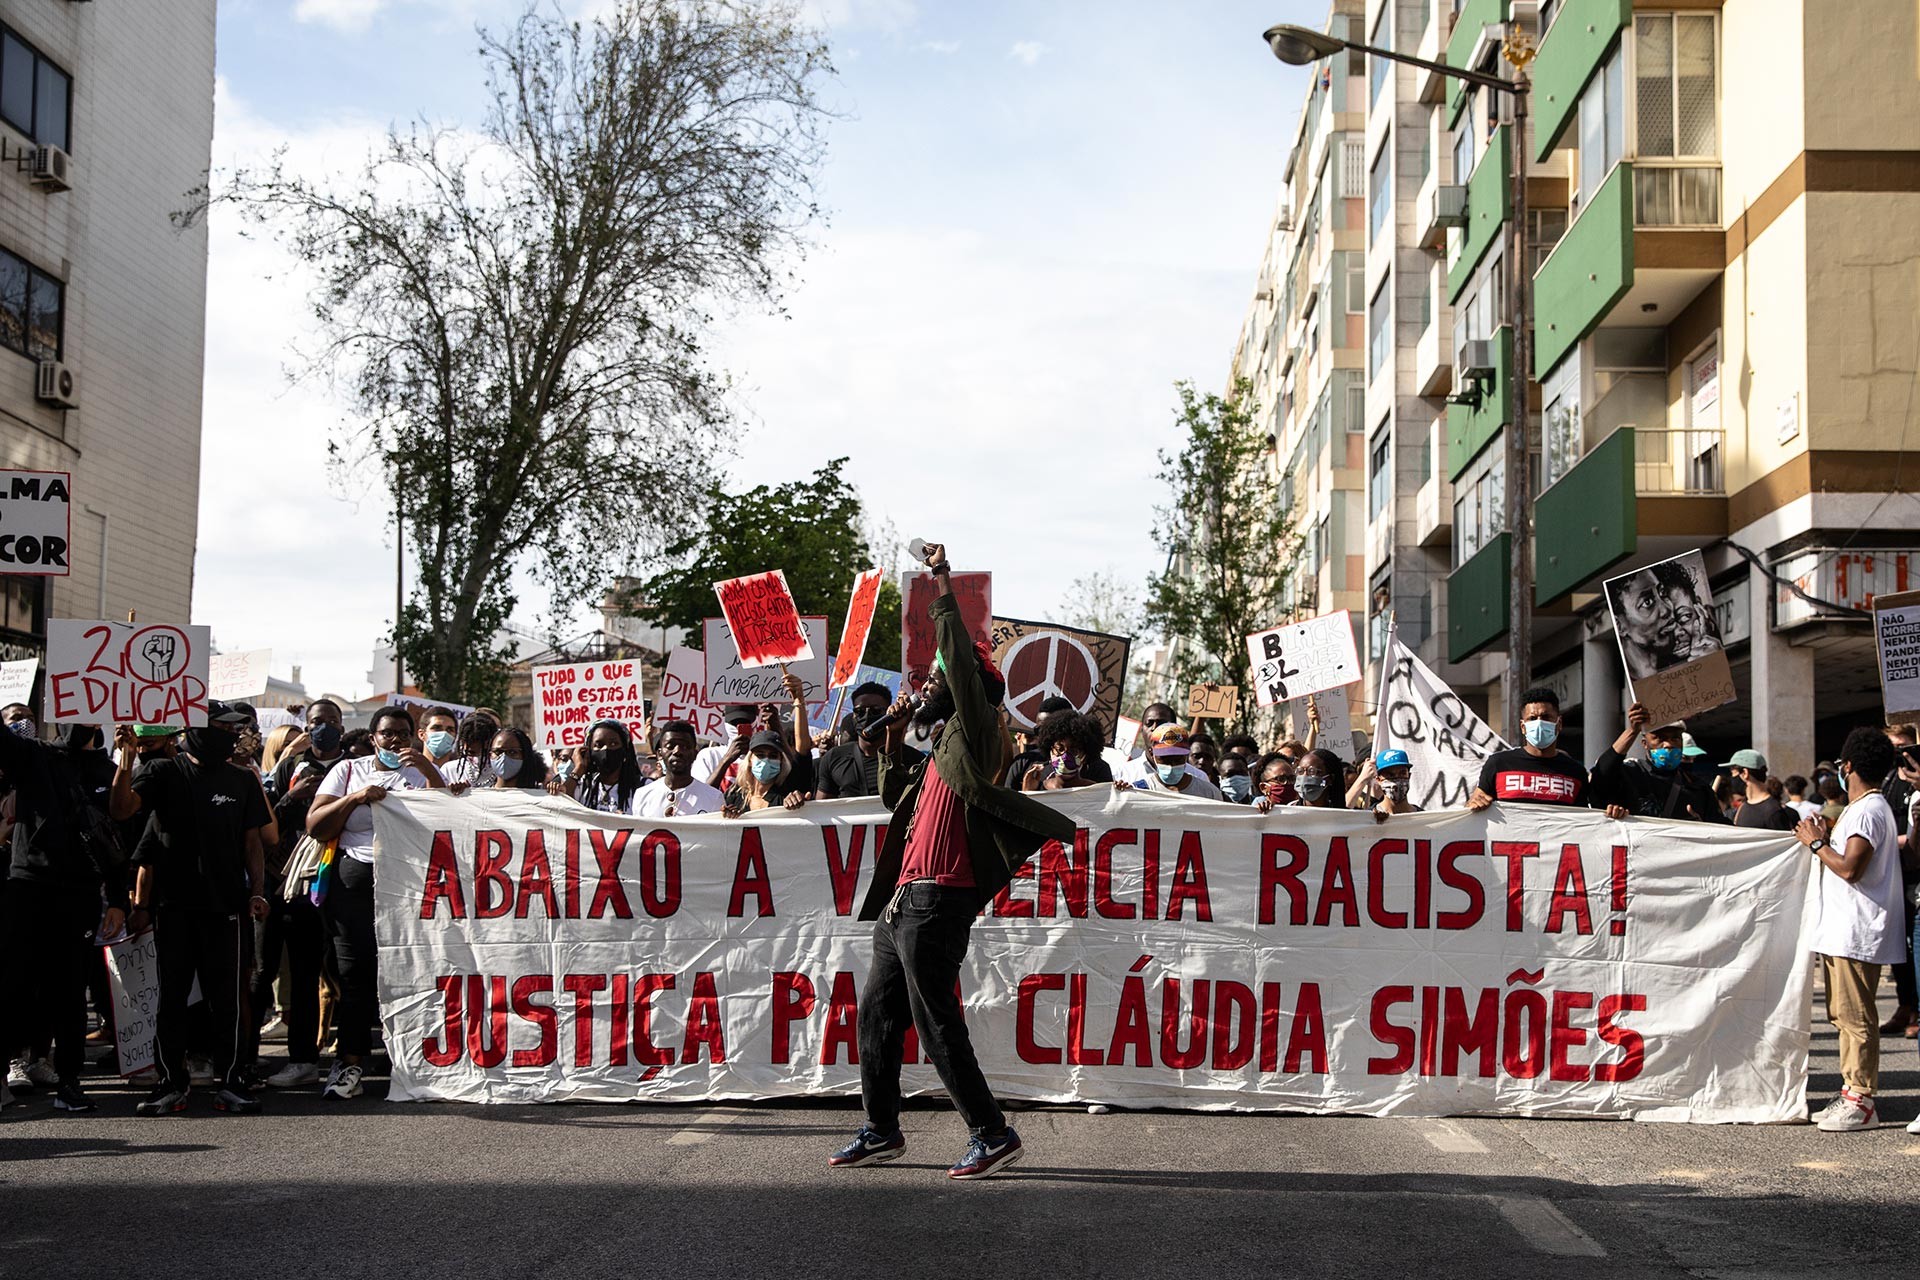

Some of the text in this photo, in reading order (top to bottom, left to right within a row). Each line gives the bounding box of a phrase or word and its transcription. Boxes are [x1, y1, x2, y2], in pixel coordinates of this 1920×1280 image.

[0, 477, 70, 503] MA
[1881, 613, 1905, 625] NÃO
[1884, 636, 1907, 648] NEM
[536, 663, 633, 687] TUDO O QUE
[1886, 658, 1909, 670] NEM
[1887, 668, 1917, 681] FOME
[50, 675, 209, 728] EDUCAR
[542, 681, 638, 706] NÃO ESTÁS A
[1189, 688, 1234, 713] BLM
[543, 701, 642, 726] MUDAR ESTÁS
[545, 730, 556, 745] A
[1505, 774, 1575, 797] SUPER
[419, 827, 683, 920] ABAIXO
[727, 826, 776, 918] A
[1258, 833, 1628, 937] RACISTA!
[121, 985, 159, 1009] ACISMO
[421, 954, 1647, 1083] JUSTIÇA PA CLÁUDIA SIMÕES
[122, 1040, 154, 1067] ELHOR
